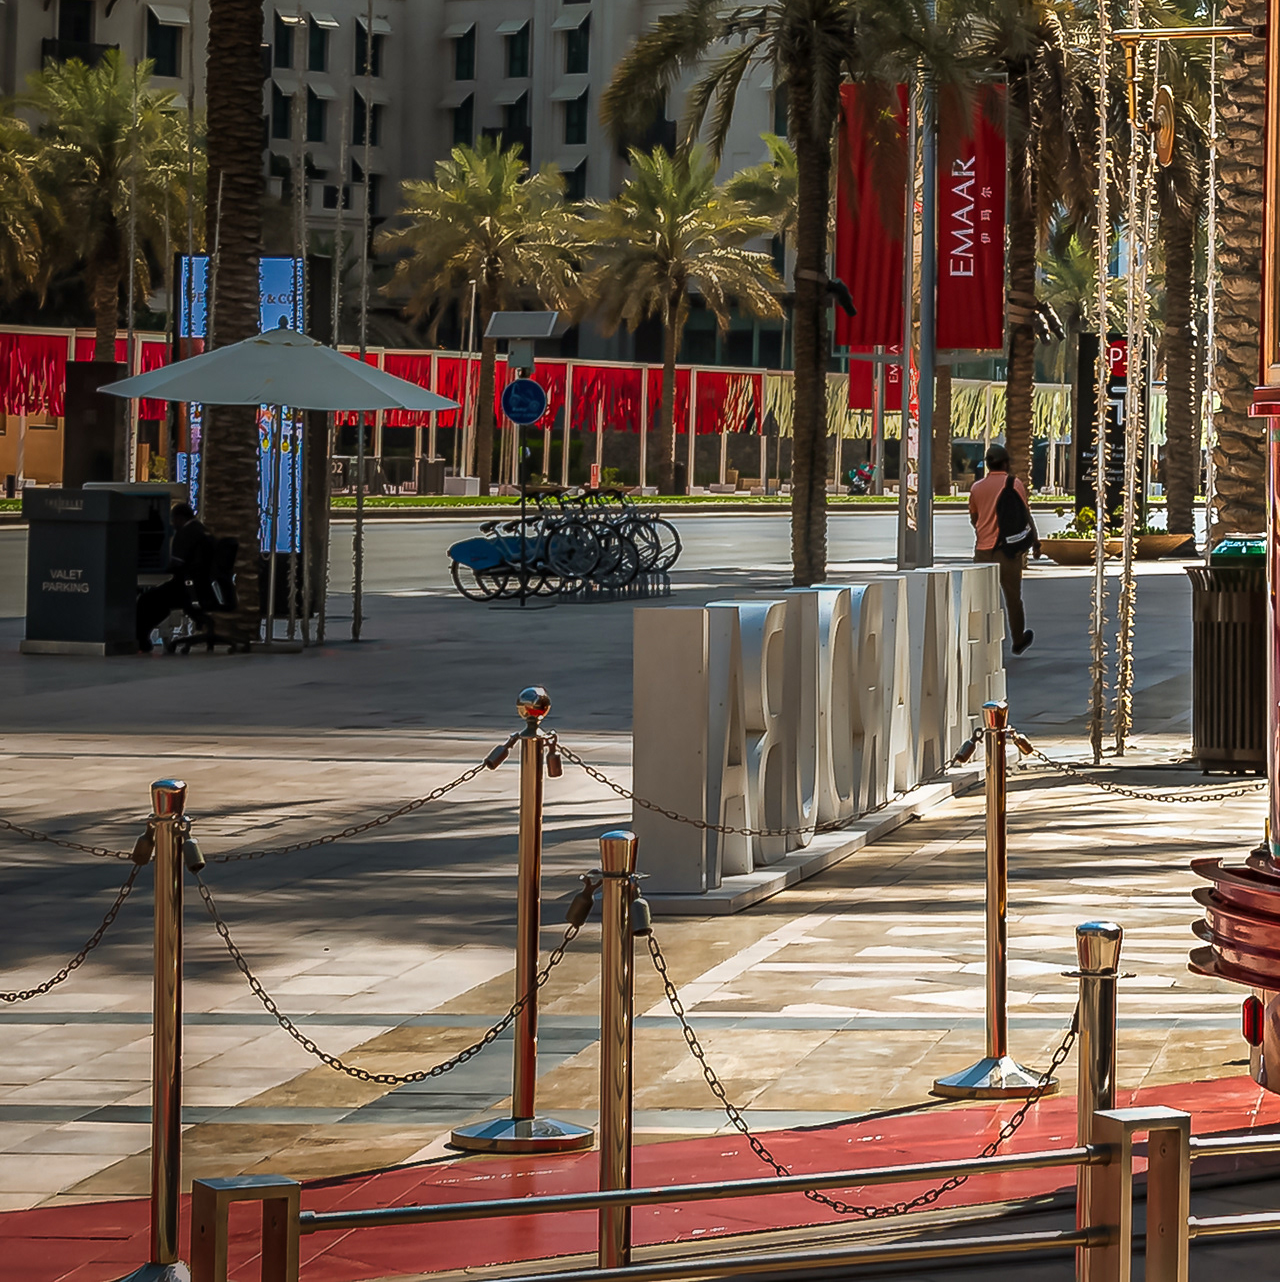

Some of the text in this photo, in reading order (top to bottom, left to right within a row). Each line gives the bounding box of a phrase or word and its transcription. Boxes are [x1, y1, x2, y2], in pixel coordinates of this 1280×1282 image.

[949, 155, 976, 277] EMAAR
[49, 569, 83, 580] VALET
[42, 581, 90, 594] PARKING
